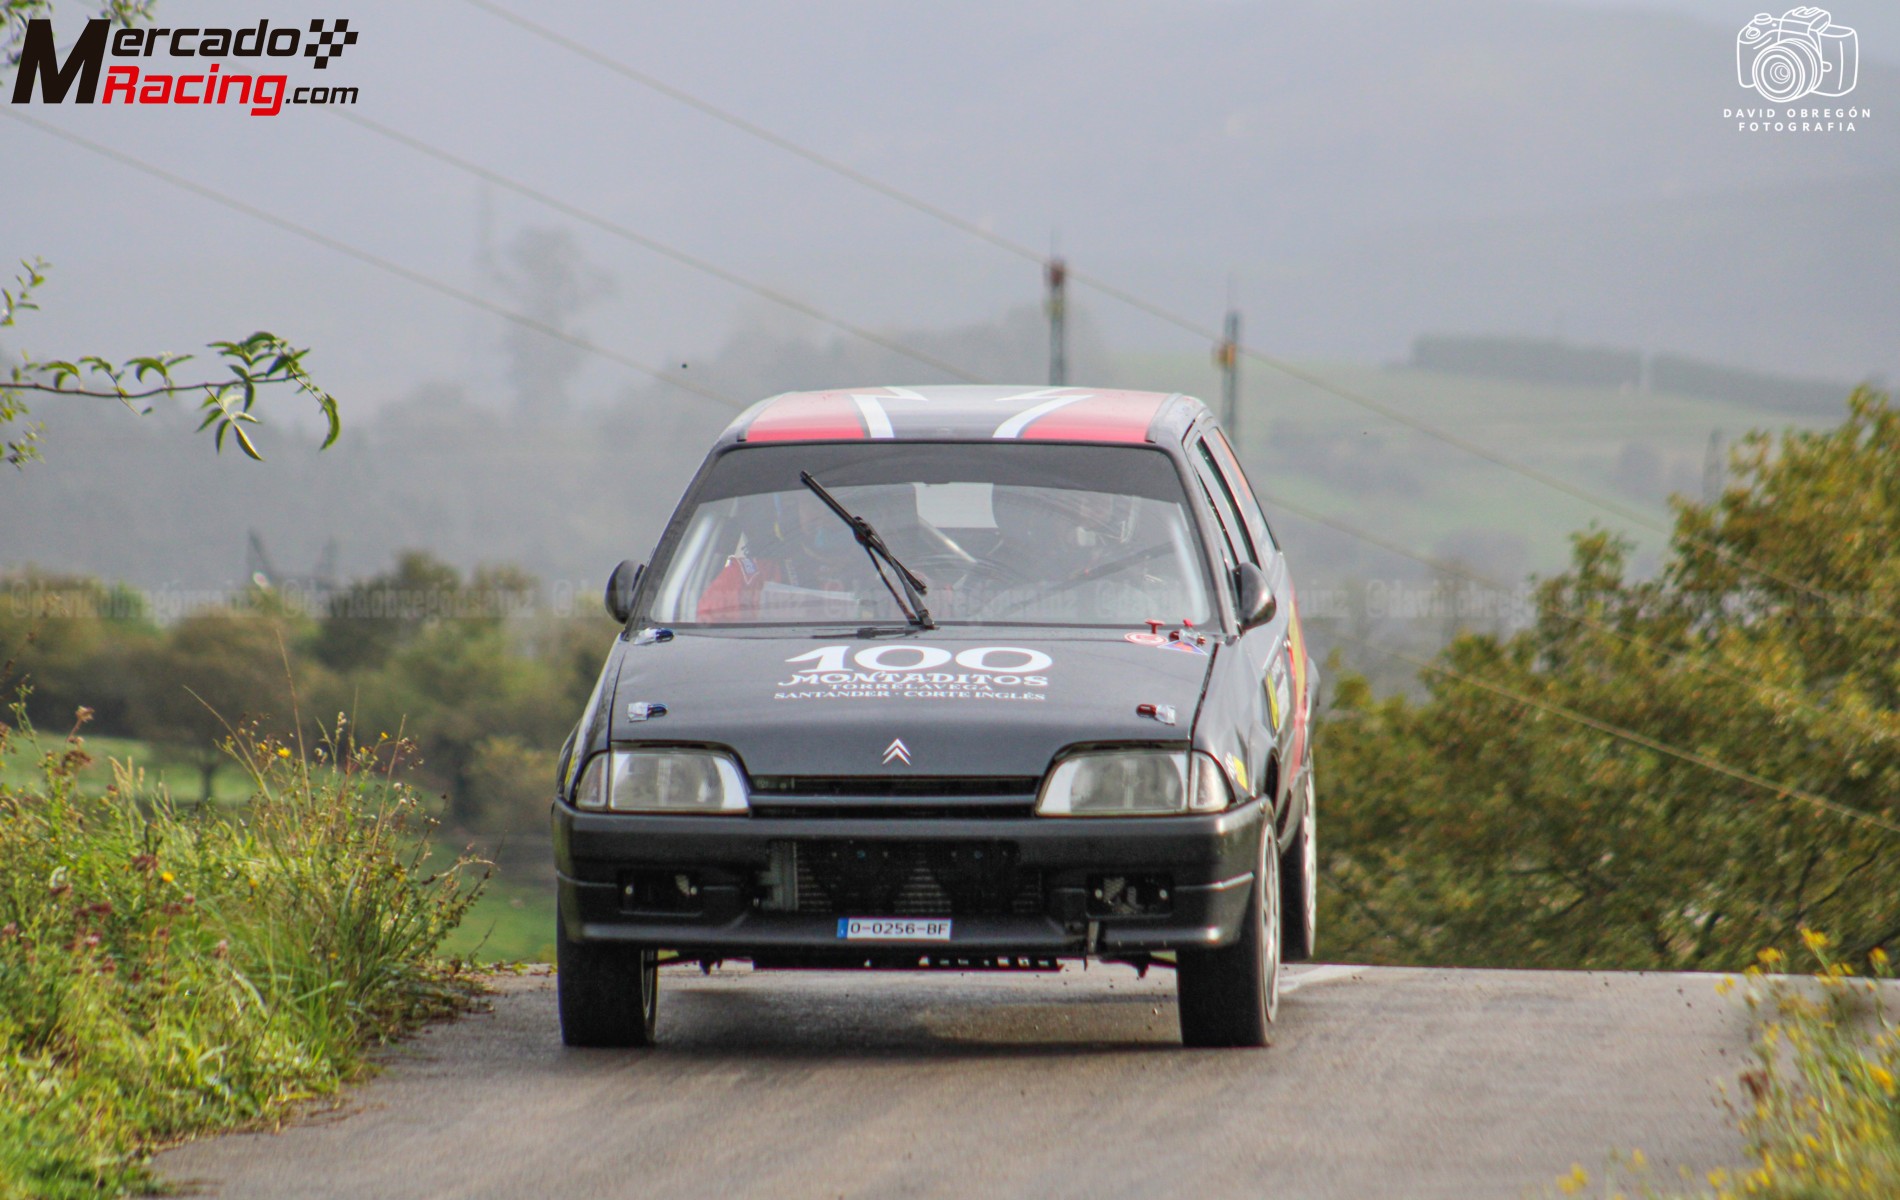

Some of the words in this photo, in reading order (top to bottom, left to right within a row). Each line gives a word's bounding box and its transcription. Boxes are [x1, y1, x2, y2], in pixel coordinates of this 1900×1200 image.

[785, 645, 1053, 673] 100
[778, 671, 1048, 687] MONTADITOS
[828, 683, 993, 691] TORRELAVEGA
[774, 690, 891, 699] SANTANDER
[903, 690, 970, 698] CORTE
